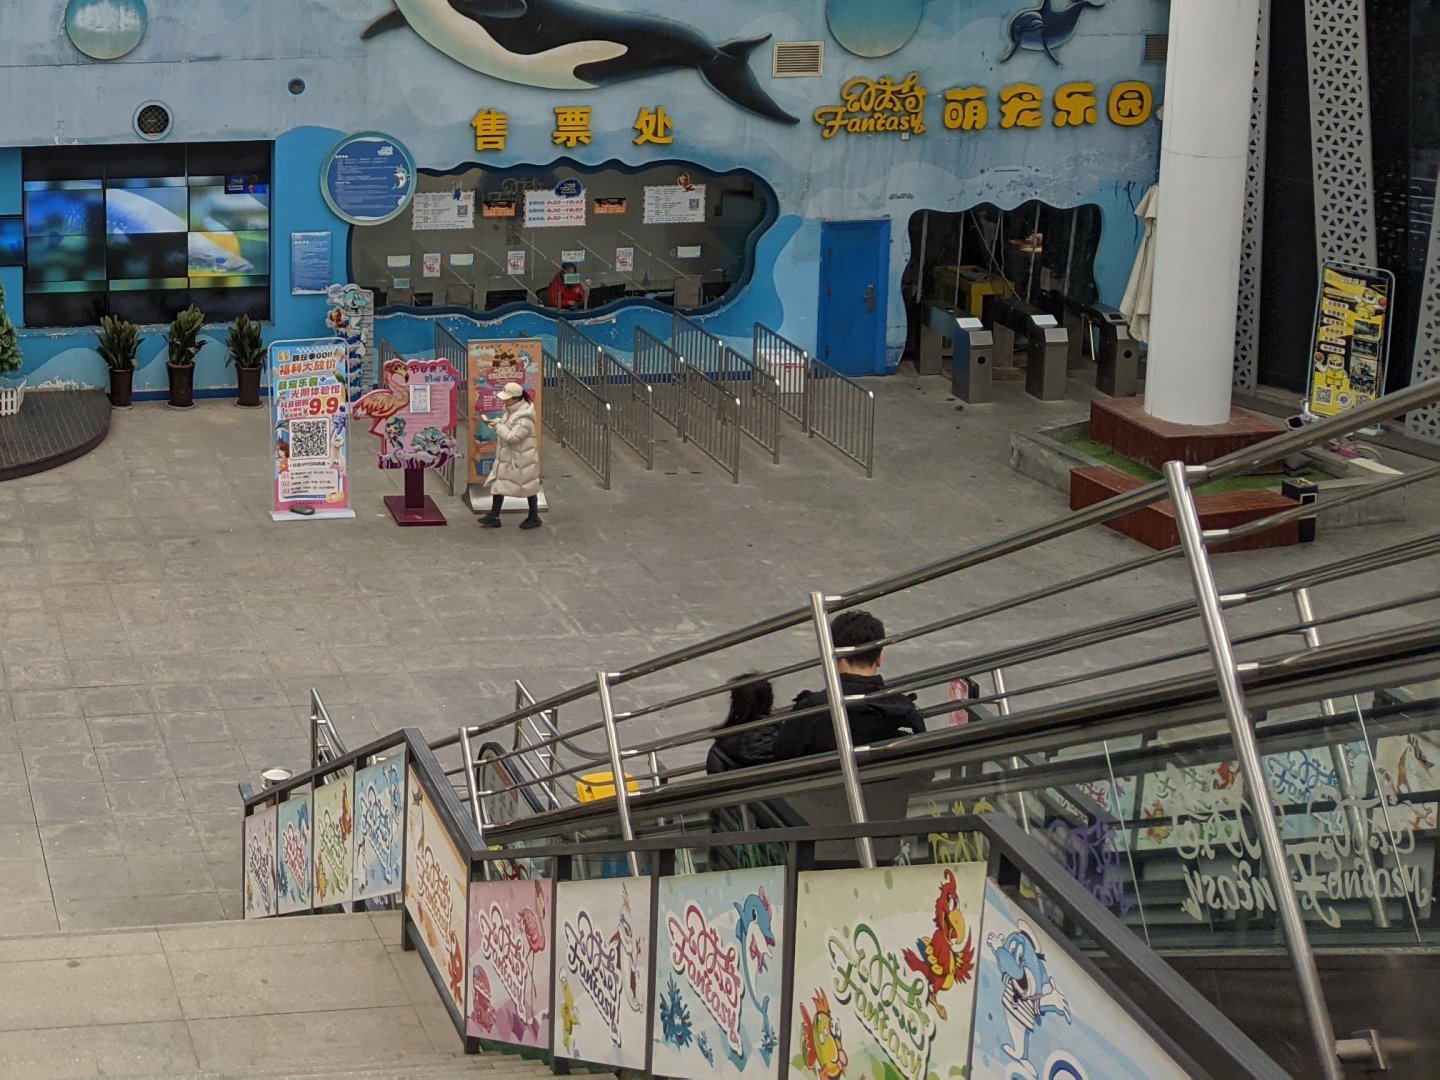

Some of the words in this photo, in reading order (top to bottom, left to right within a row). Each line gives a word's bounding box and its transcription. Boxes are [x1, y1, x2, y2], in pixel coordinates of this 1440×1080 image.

[814, 107, 928, 139] Fantasy
[944, 81, 1152, 131] 萌宠乐园
[471, 107, 675, 150] 售票处
[279, 359, 336, 375] 福利大放价
